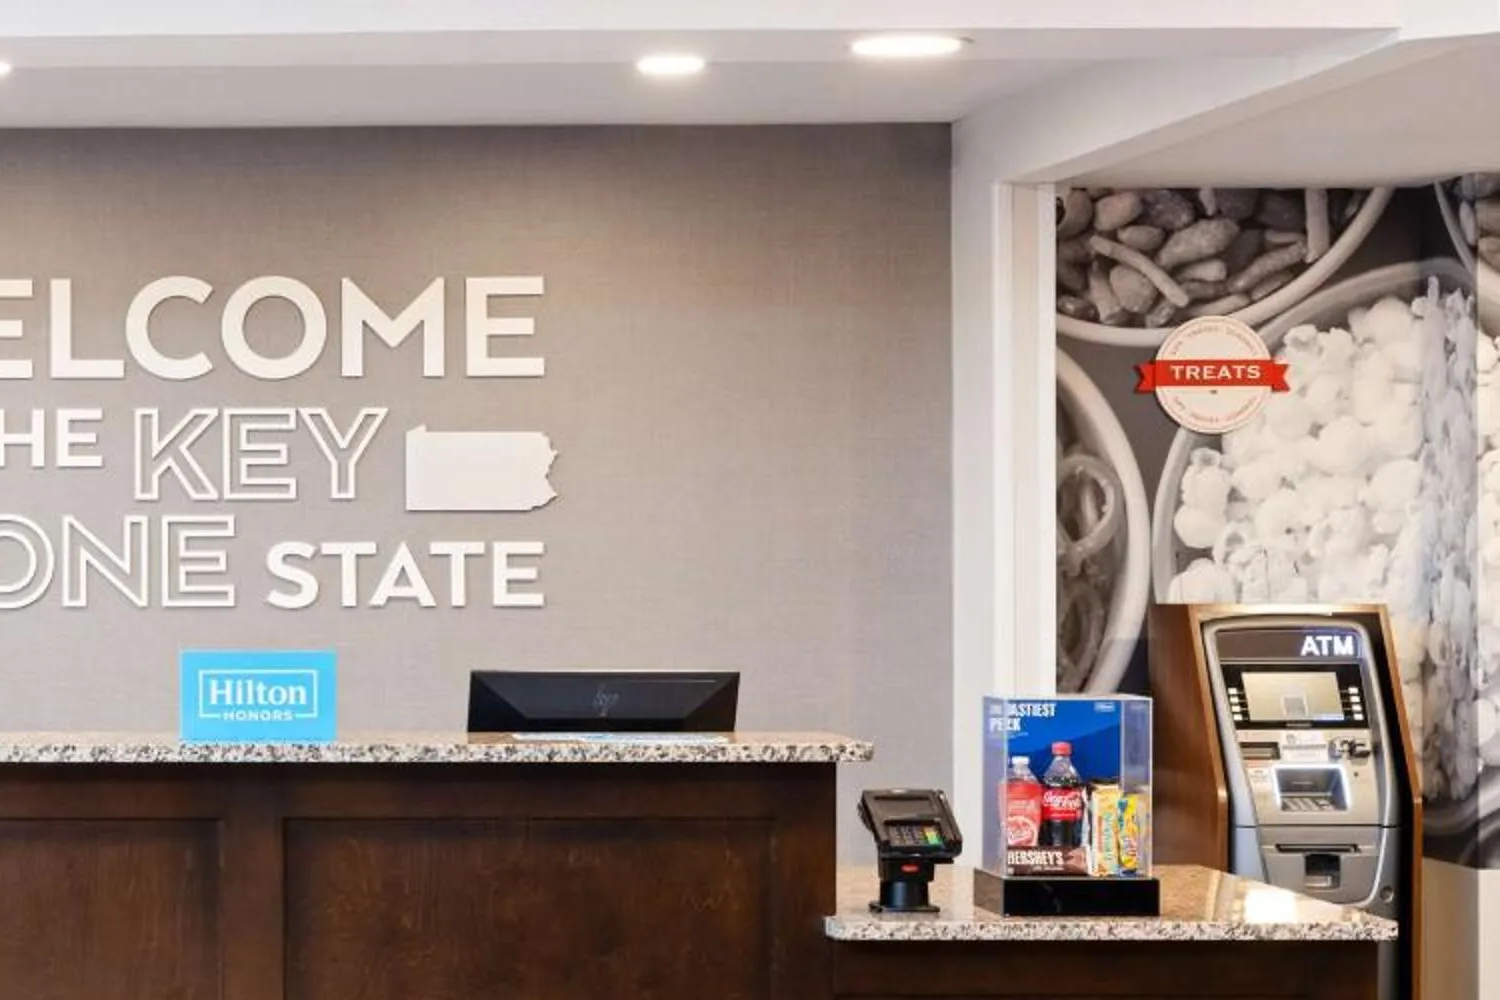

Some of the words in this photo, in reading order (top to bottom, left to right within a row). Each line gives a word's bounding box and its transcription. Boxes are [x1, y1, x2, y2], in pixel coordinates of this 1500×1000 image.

[1170, 365, 1261, 381] TREATS
[133, 406, 389, 502] KEY
[265, 541, 546, 610] STATE
[1300, 636, 1354, 656] ATM
[209, 679, 307, 706] Hilton
[223, 709, 294, 721] HONORS
